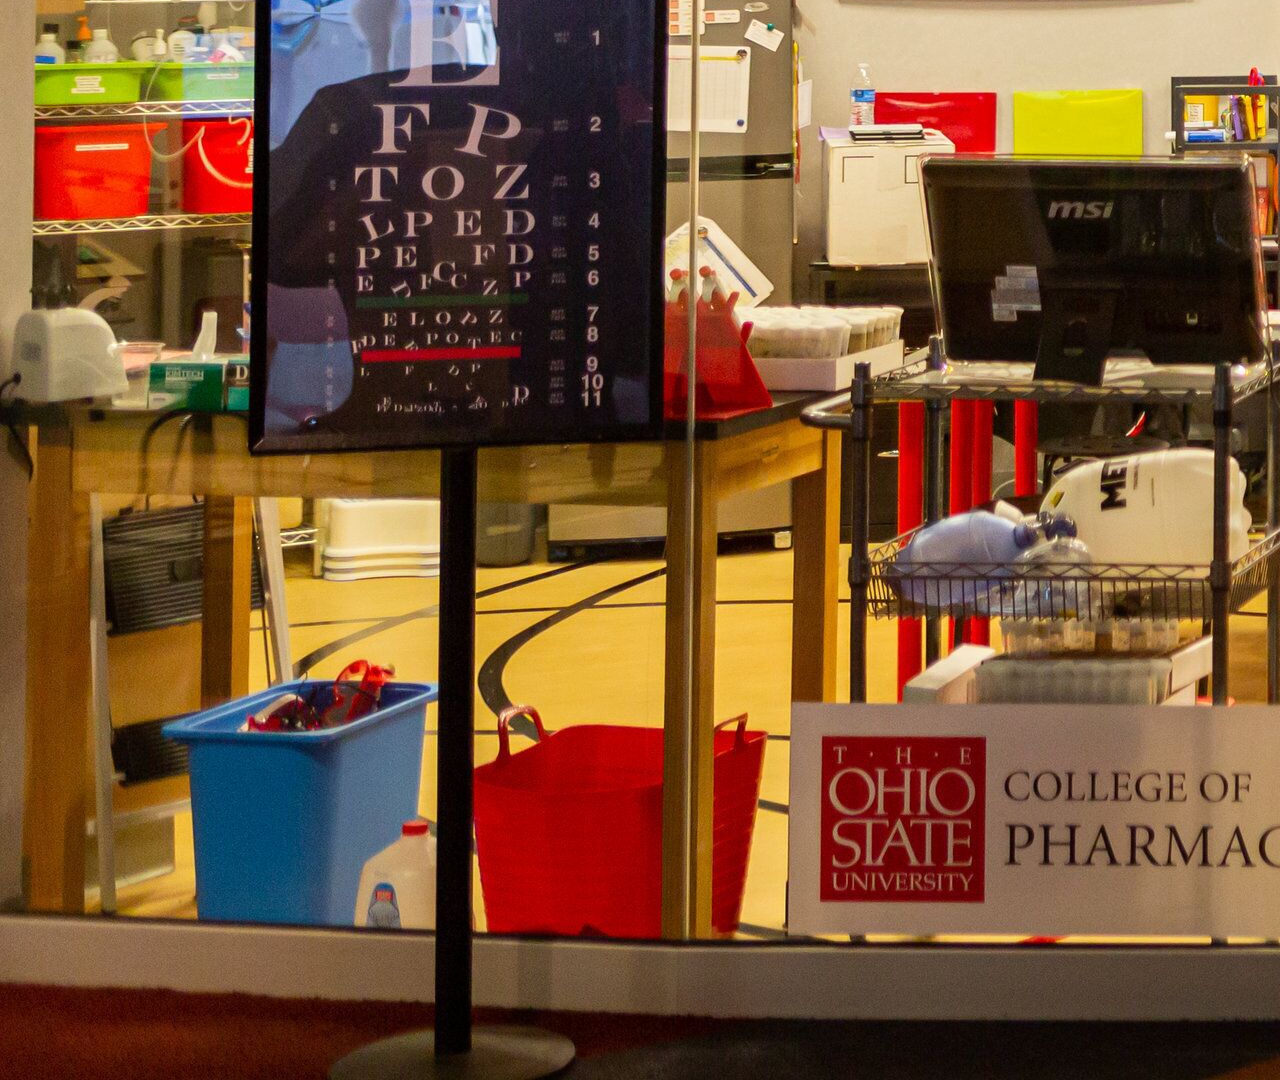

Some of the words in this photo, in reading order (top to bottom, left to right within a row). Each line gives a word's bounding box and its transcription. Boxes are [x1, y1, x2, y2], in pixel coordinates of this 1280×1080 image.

[592, 30, 602, 47] 1
[589, 116, 602, 132] 2
[589, 172, 601, 189] 3
[1047, 198, 1115, 220] msi
[588, 212, 601, 229] 4
[587, 244, 601, 262] 5
[586, 270, 600, 287] 6
[586, 306, 600, 322] 7
[586, 326, 600, 343] 8
[585, 356, 599, 372] 9
[580, 373, 605, 390] 10
[581, 390, 602, 408] 11
[828, 766, 977, 818] OHIO
[1003, 770, 1189, 804] COLLEGE
[1199, 772, 1252, 804] OF
[830, 819, 975, 869] STATE
[831, 872, 975, 894] UNIVERSITY
